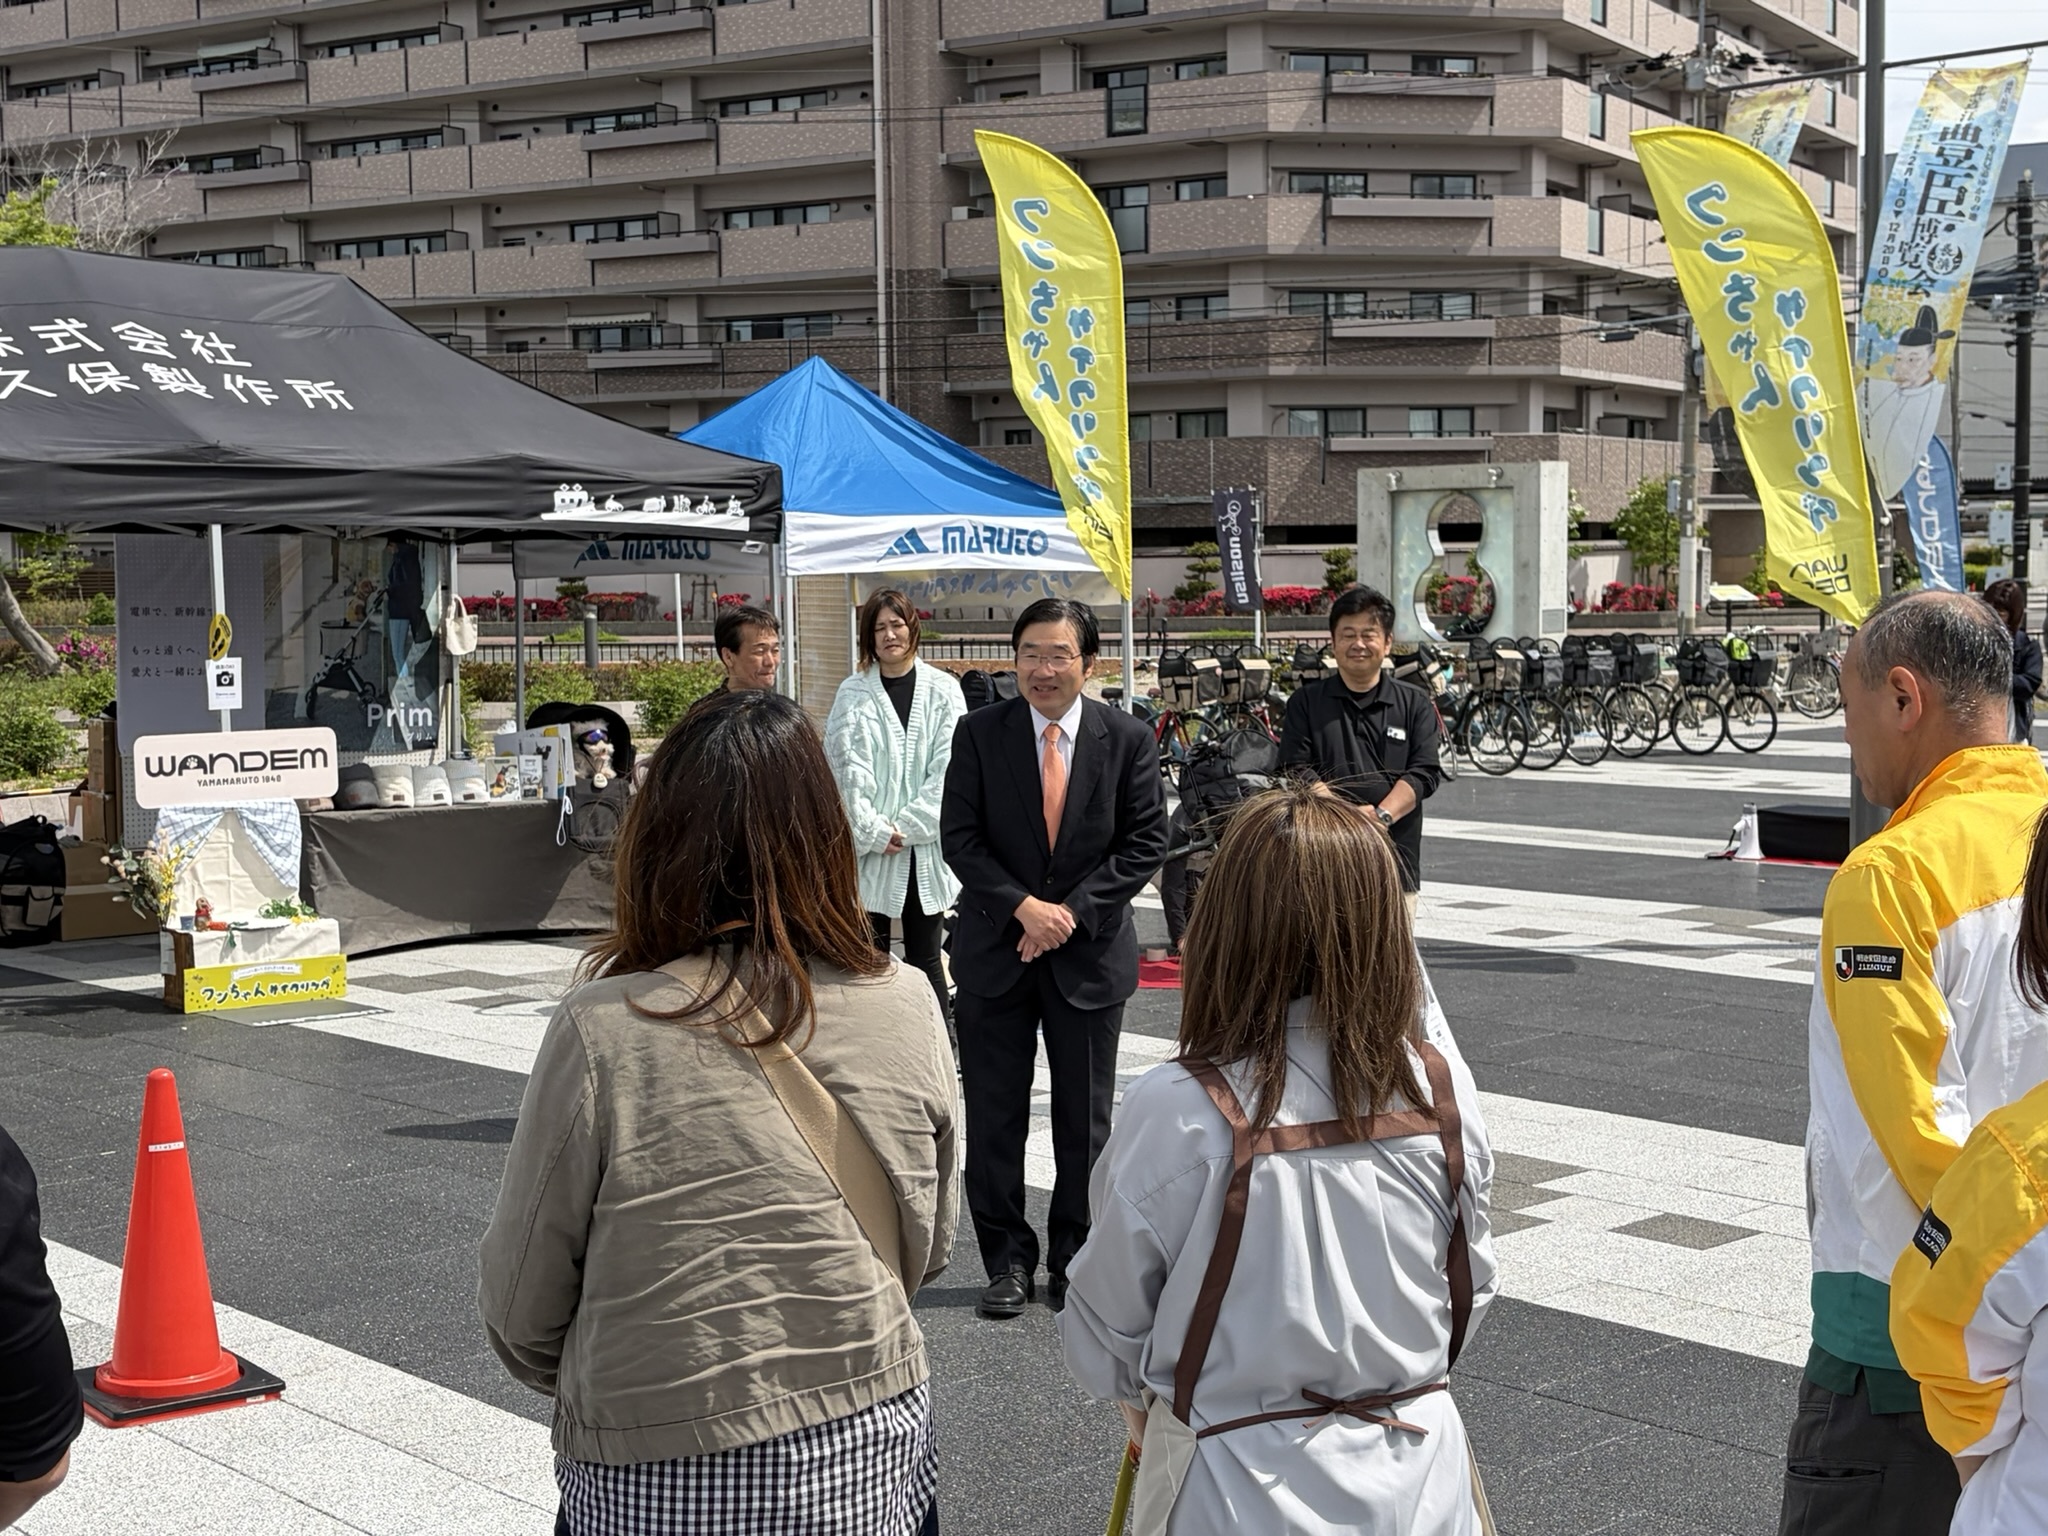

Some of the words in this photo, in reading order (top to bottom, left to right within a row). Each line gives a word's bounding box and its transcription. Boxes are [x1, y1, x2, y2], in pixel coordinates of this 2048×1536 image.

[942, 524, 1049, 557] MARUTO
[367, 702, 433, 728] Prim
[197, 775, 260, 788] YAMAMARUTO
[202, 982, 265, 1004] ワンちゃん
[270, 978, 330, 995] サイクリング
